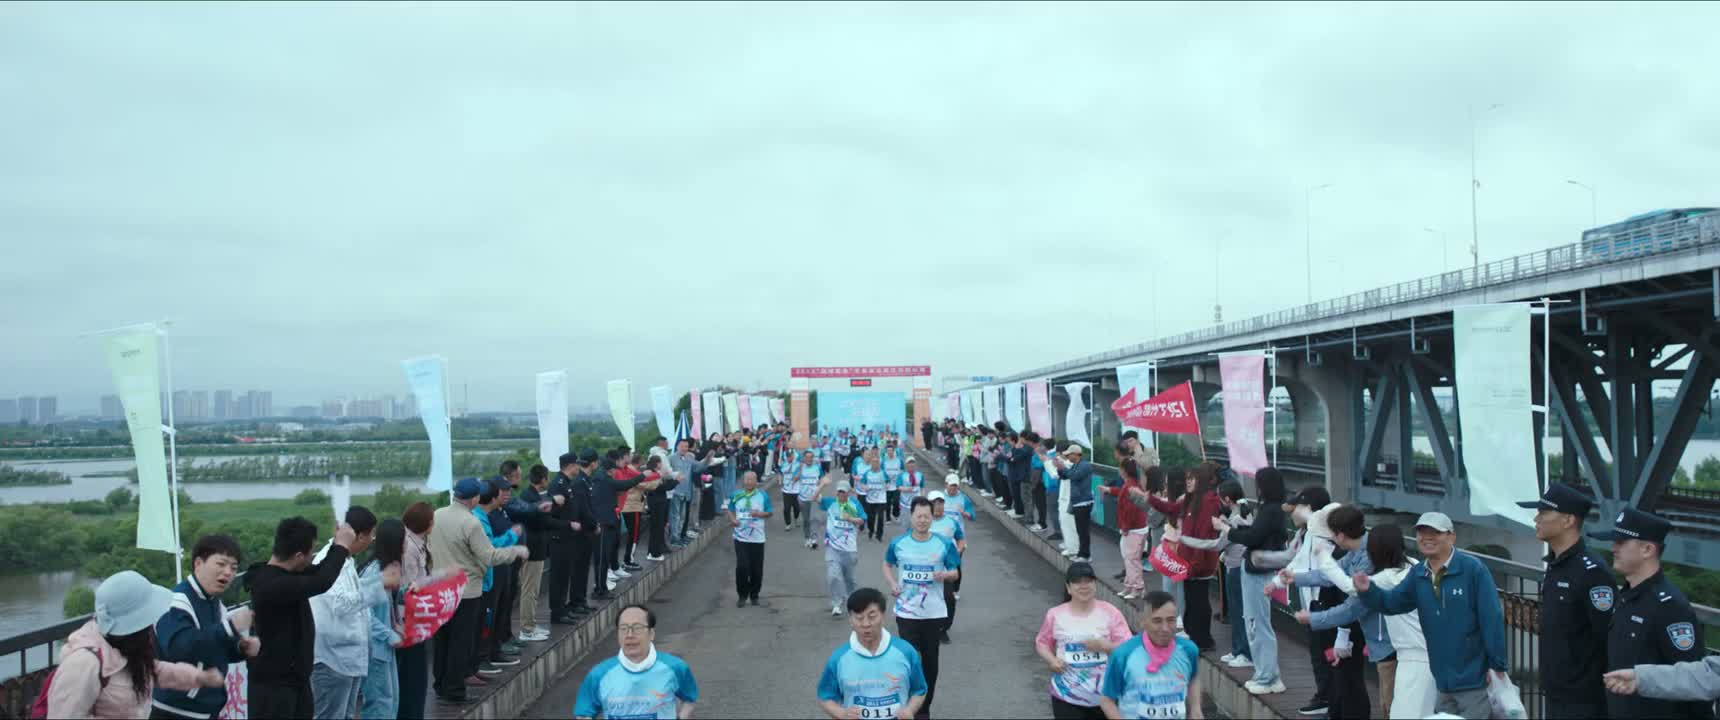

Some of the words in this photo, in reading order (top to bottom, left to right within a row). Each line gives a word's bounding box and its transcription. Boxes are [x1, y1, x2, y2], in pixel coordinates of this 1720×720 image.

[907, 572, 929, 580] 002
[1072, 651, 1101, 662] 054
[861, 707, 893, 719] 011
[1146, 706, 1179, 717] 036
